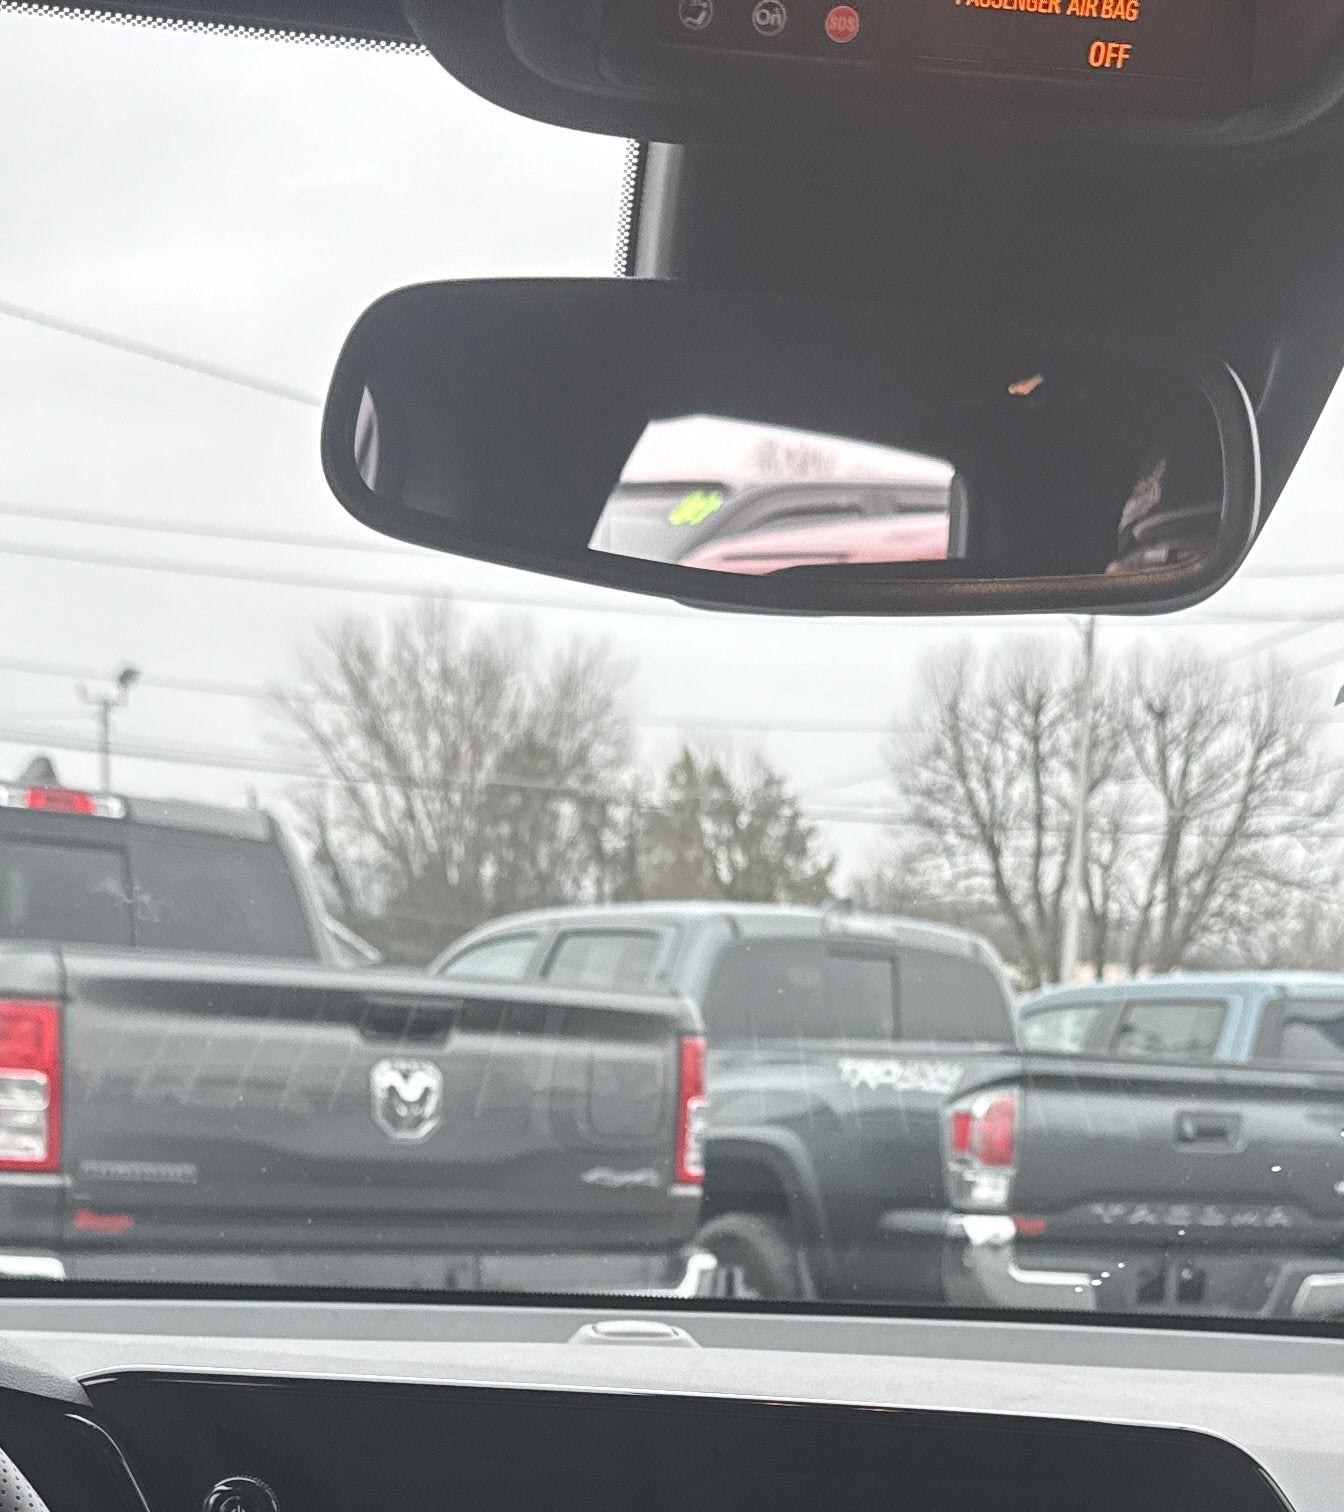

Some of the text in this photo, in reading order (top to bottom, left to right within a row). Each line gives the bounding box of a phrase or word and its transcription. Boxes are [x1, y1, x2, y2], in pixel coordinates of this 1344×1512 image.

[956, 0, 1141, 21] ENGER AIR BAG
[1088, 41, 1133, 68] OFF
